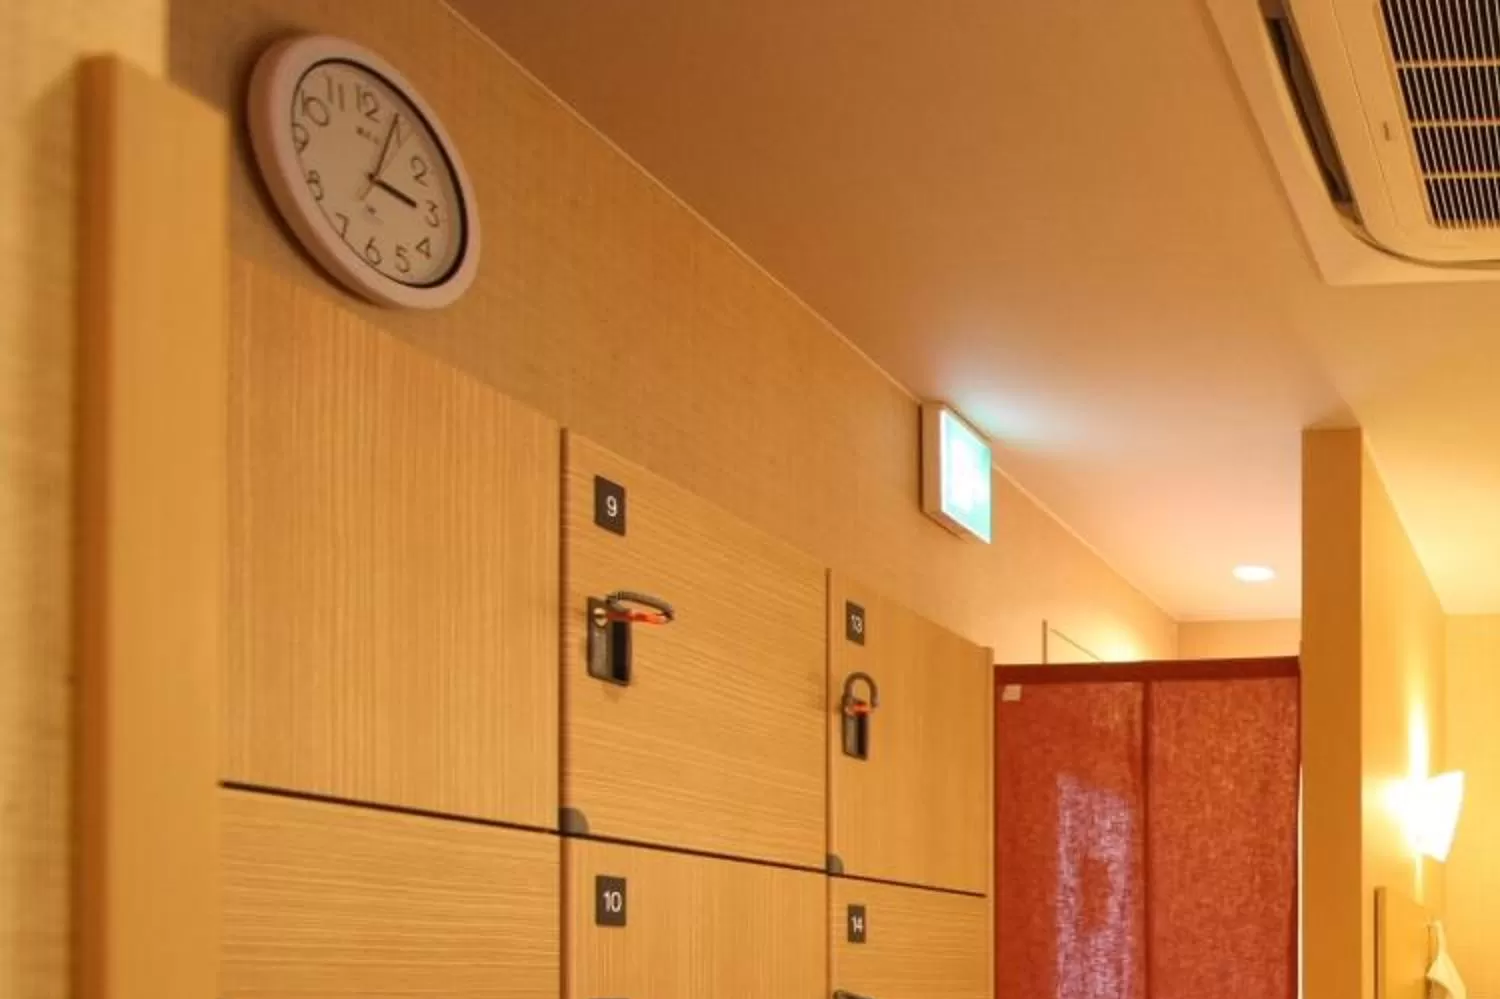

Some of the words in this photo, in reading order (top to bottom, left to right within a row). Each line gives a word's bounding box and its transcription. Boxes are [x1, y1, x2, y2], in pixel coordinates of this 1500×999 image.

[322, 71, 346, 112] 11
[354, 82, 381, 123] 12
[306, 169, 325, 201] 8
[409, 154, 429, 188] 2
[335, 211, 350, 240] 7
[424, 200, 441, 228] 3
[364, 236, 383, 266] 6
[395, 245, 411, 273] 5
[415, 236, 433, 260] 4
[605, 495, 618, 517] 9
[851, 614, 863, 633] 13
[603, 890, 623, 912] 10
[851, 915, 864, 933] 14
